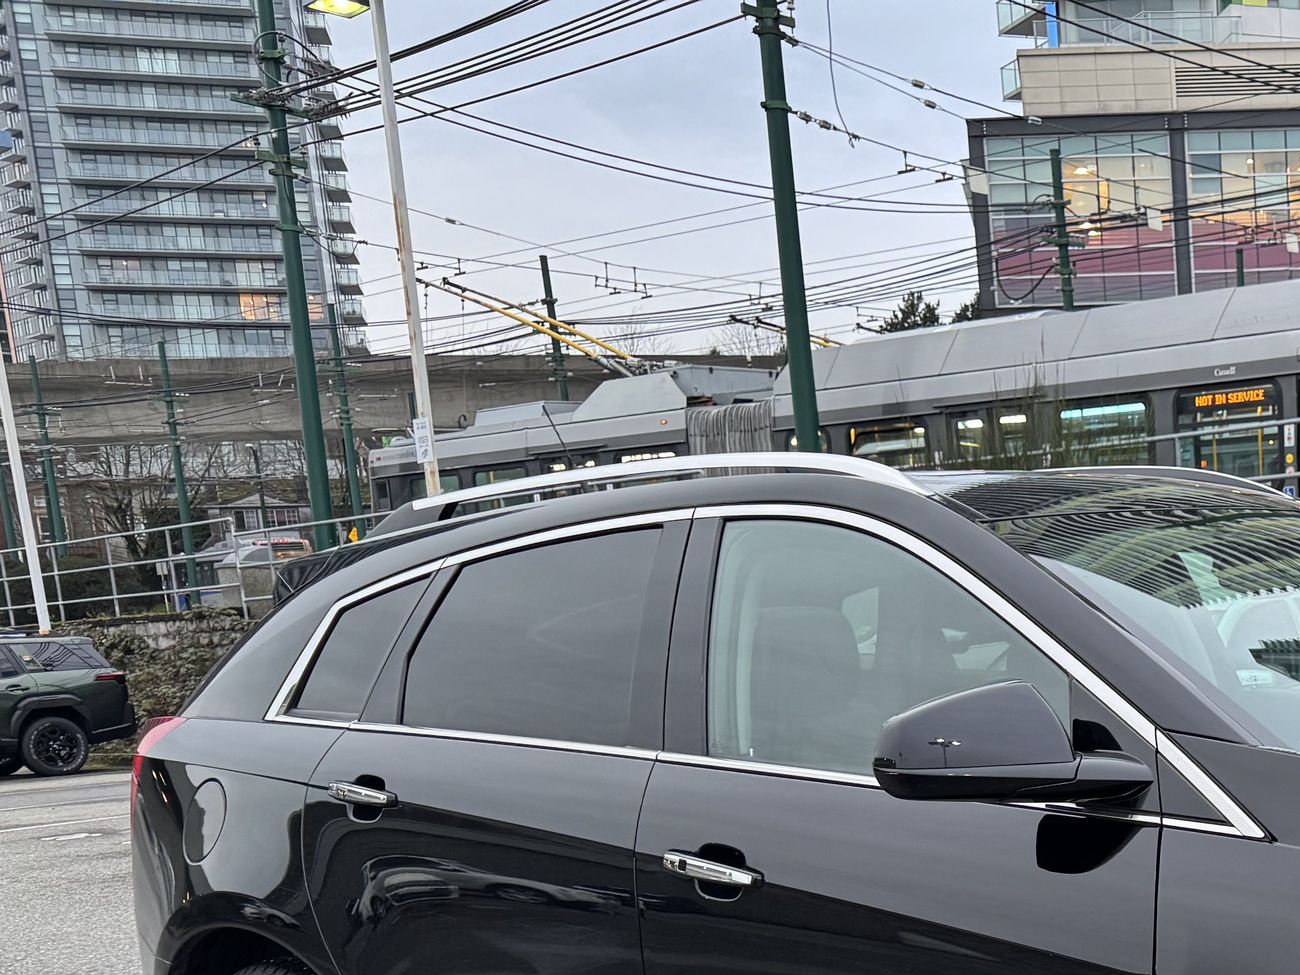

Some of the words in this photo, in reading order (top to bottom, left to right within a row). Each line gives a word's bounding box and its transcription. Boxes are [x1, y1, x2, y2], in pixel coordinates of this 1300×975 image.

[1195, 395, 1213, 407] NOT
[1215, 393, 1227, 405] IN
[1228, 389, 1265, 403] SERVICE
